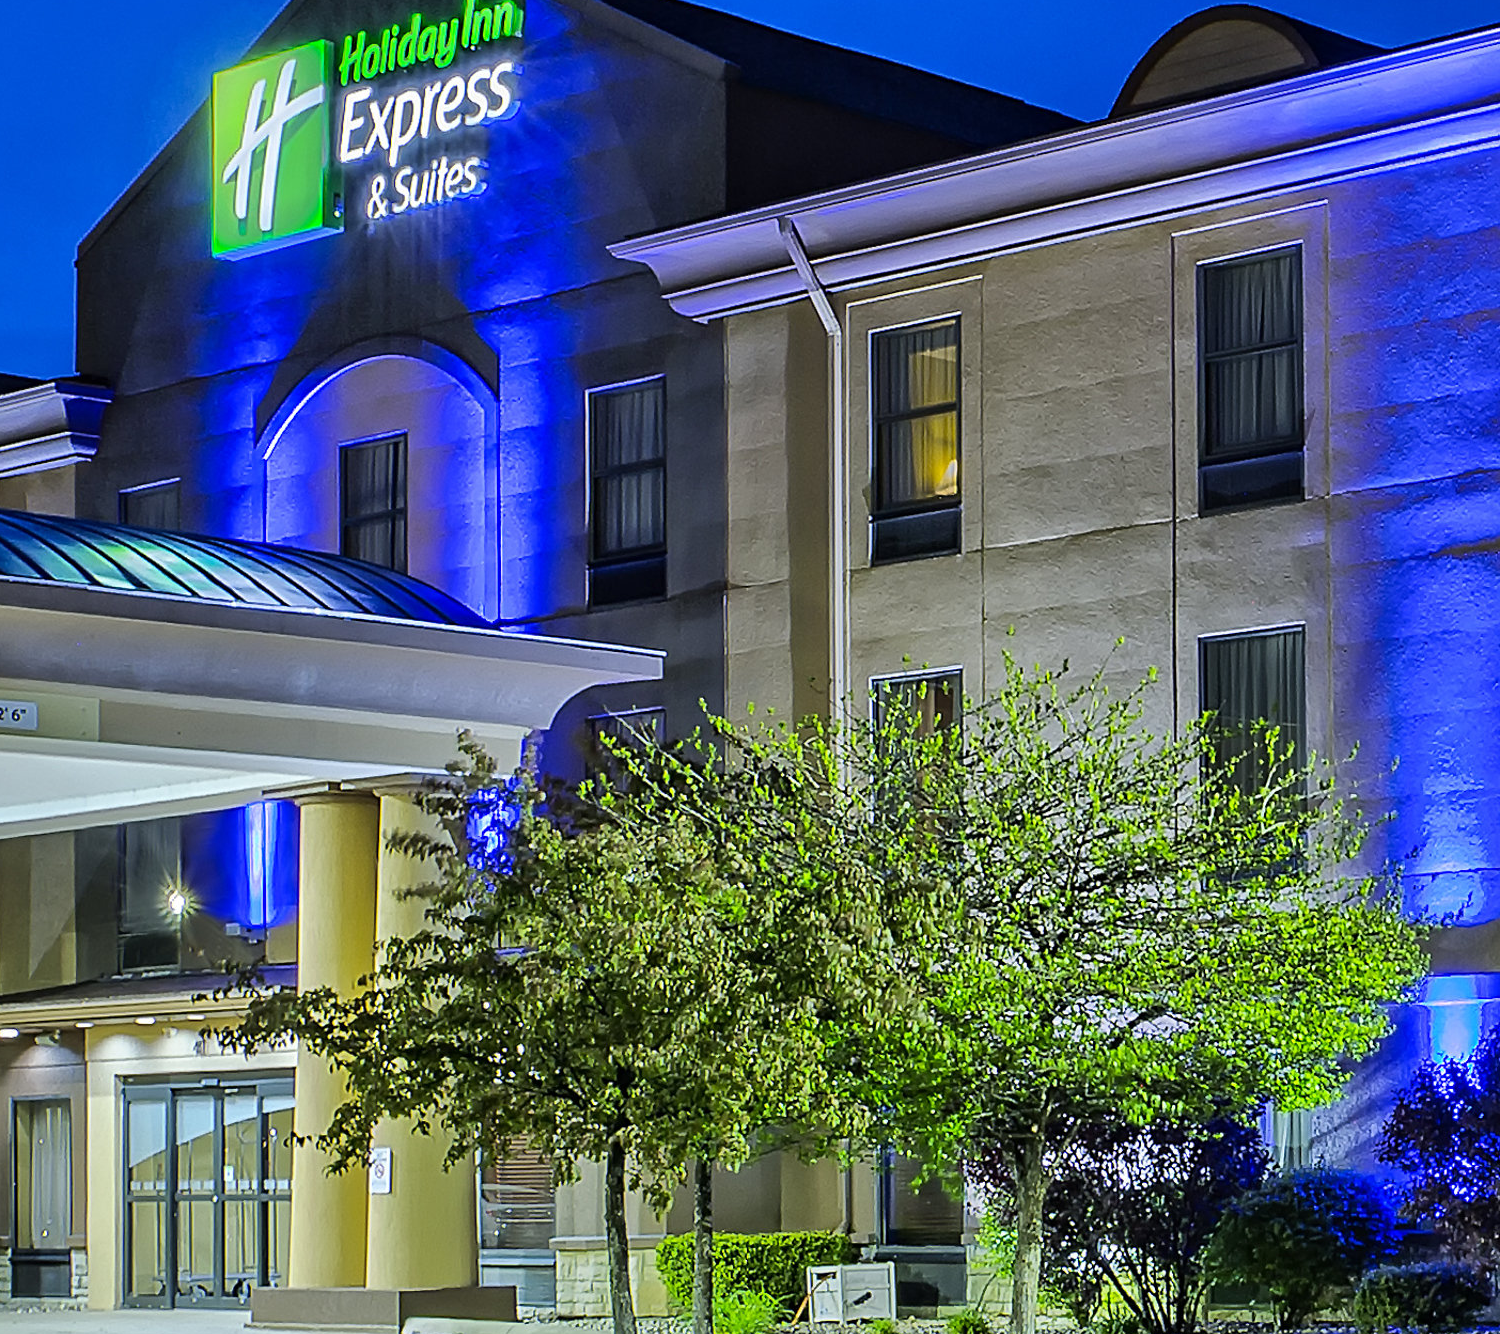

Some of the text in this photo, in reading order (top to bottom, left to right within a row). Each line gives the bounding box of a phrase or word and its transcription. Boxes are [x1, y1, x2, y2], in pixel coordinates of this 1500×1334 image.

[339, 12, 459, 86] Holiday
[339, 61, 515, 167] Express
[366, 156, 480, 220] & Suites
